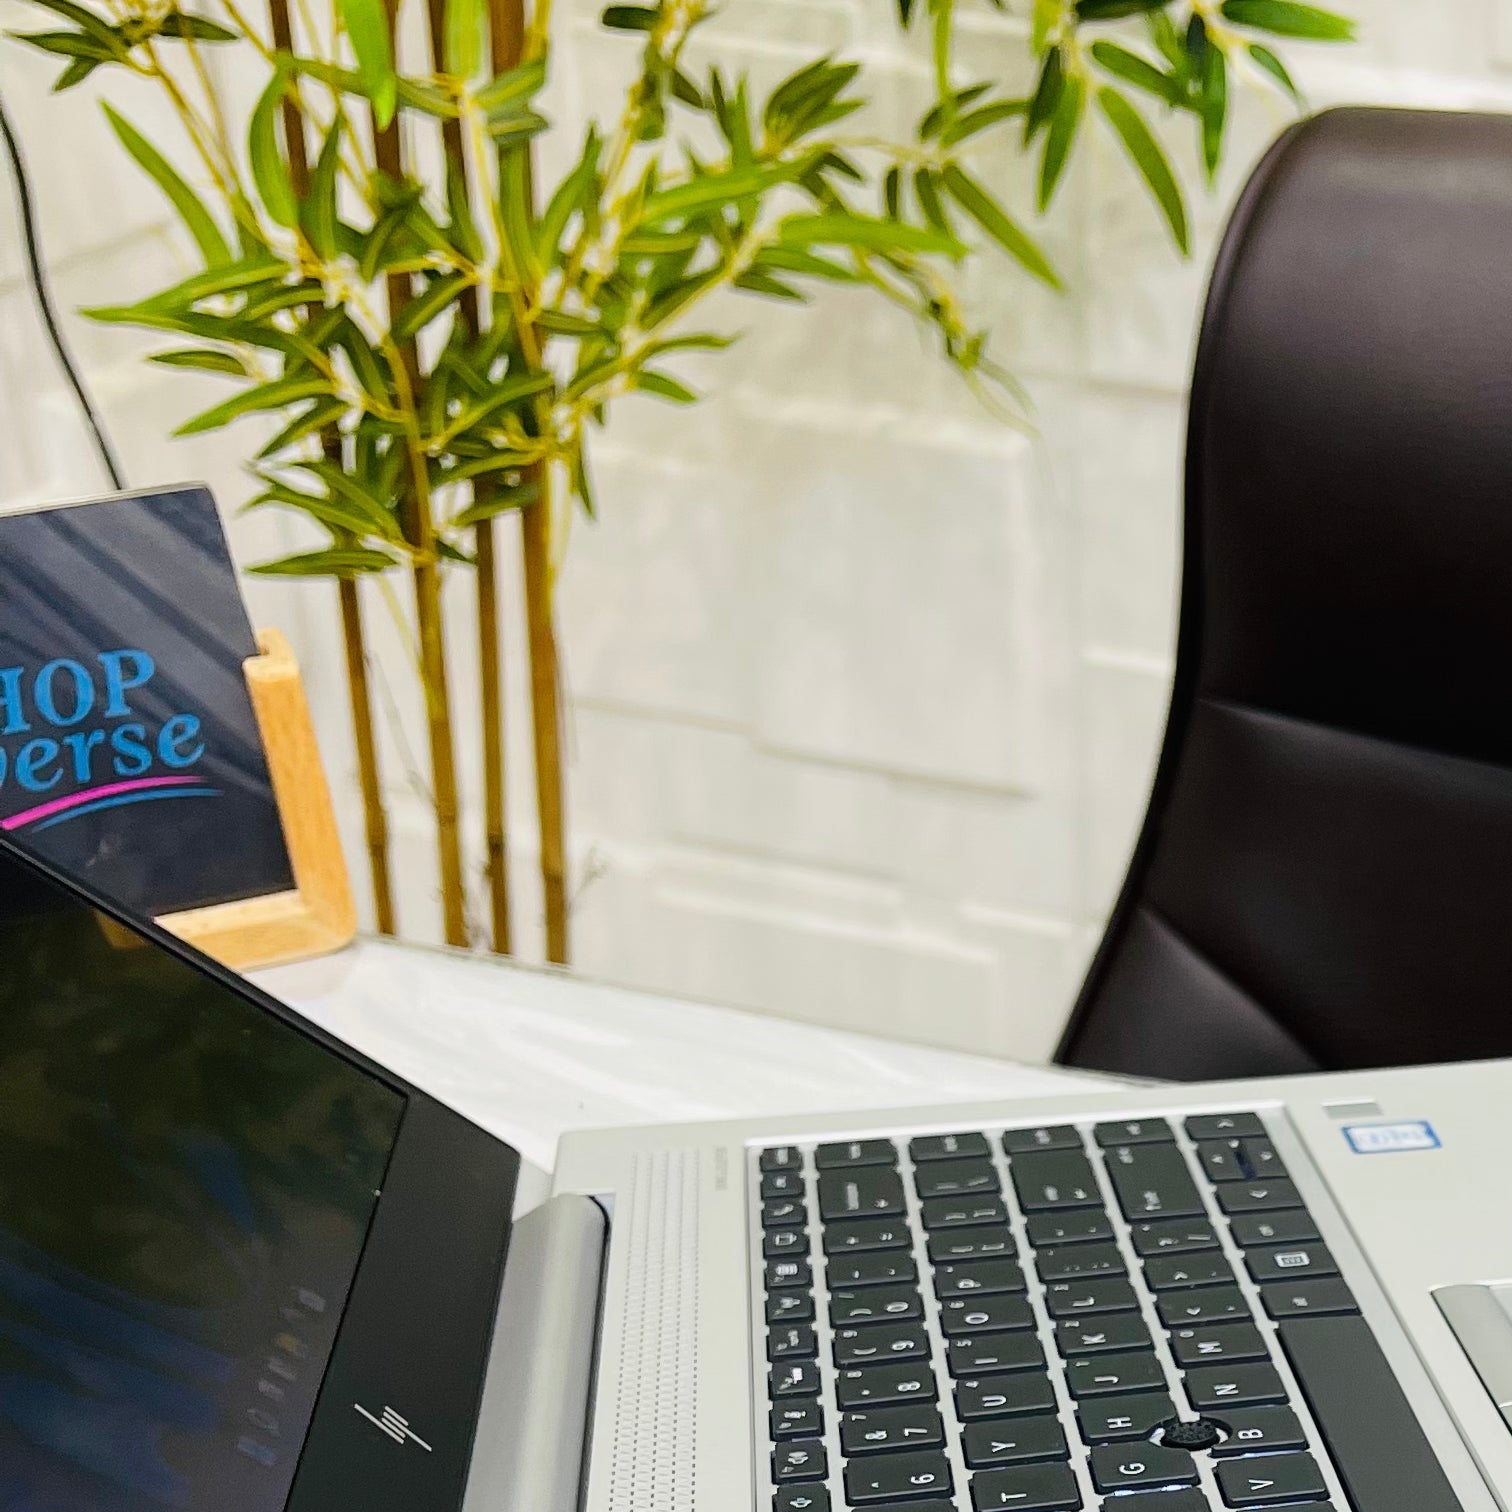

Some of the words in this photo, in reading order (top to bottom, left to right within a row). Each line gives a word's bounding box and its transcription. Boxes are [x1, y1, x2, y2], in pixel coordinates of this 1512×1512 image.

[0, 713, 205, 793] erse
[957, 1278, 982, 1288] P
[887, 1302, 908, 1312] 0
[1072, 1296, 1095, 1307] L
[964, 1312, 989, 1324] O
[1081, 1333, 1106, 1344] K
[892, 1341, 914, 1350] 9
[1197, 1341, 1223, 1354] M
[1094, 1375, 1119, 1383] J
[898, 1382, 921, 1392] 8
[1213, 1383, 1240, 1396] N
[981, 1394, 1007, 1406] U
[1107, 1416, 1133, 1429] H
[865, 1430, 888, 1440] &
[904, 1427, 928, 1436] 7
[1238, 1428, 1263, 1439] B
[991, 1441, 1016, 1452] Y
[1119, 1462, 1146, 1475] G
[911, 1473, 935, 1485] 6
[1248, 1479, 1274, 1490] V
[1001, 1492, 1027, 1503] T
